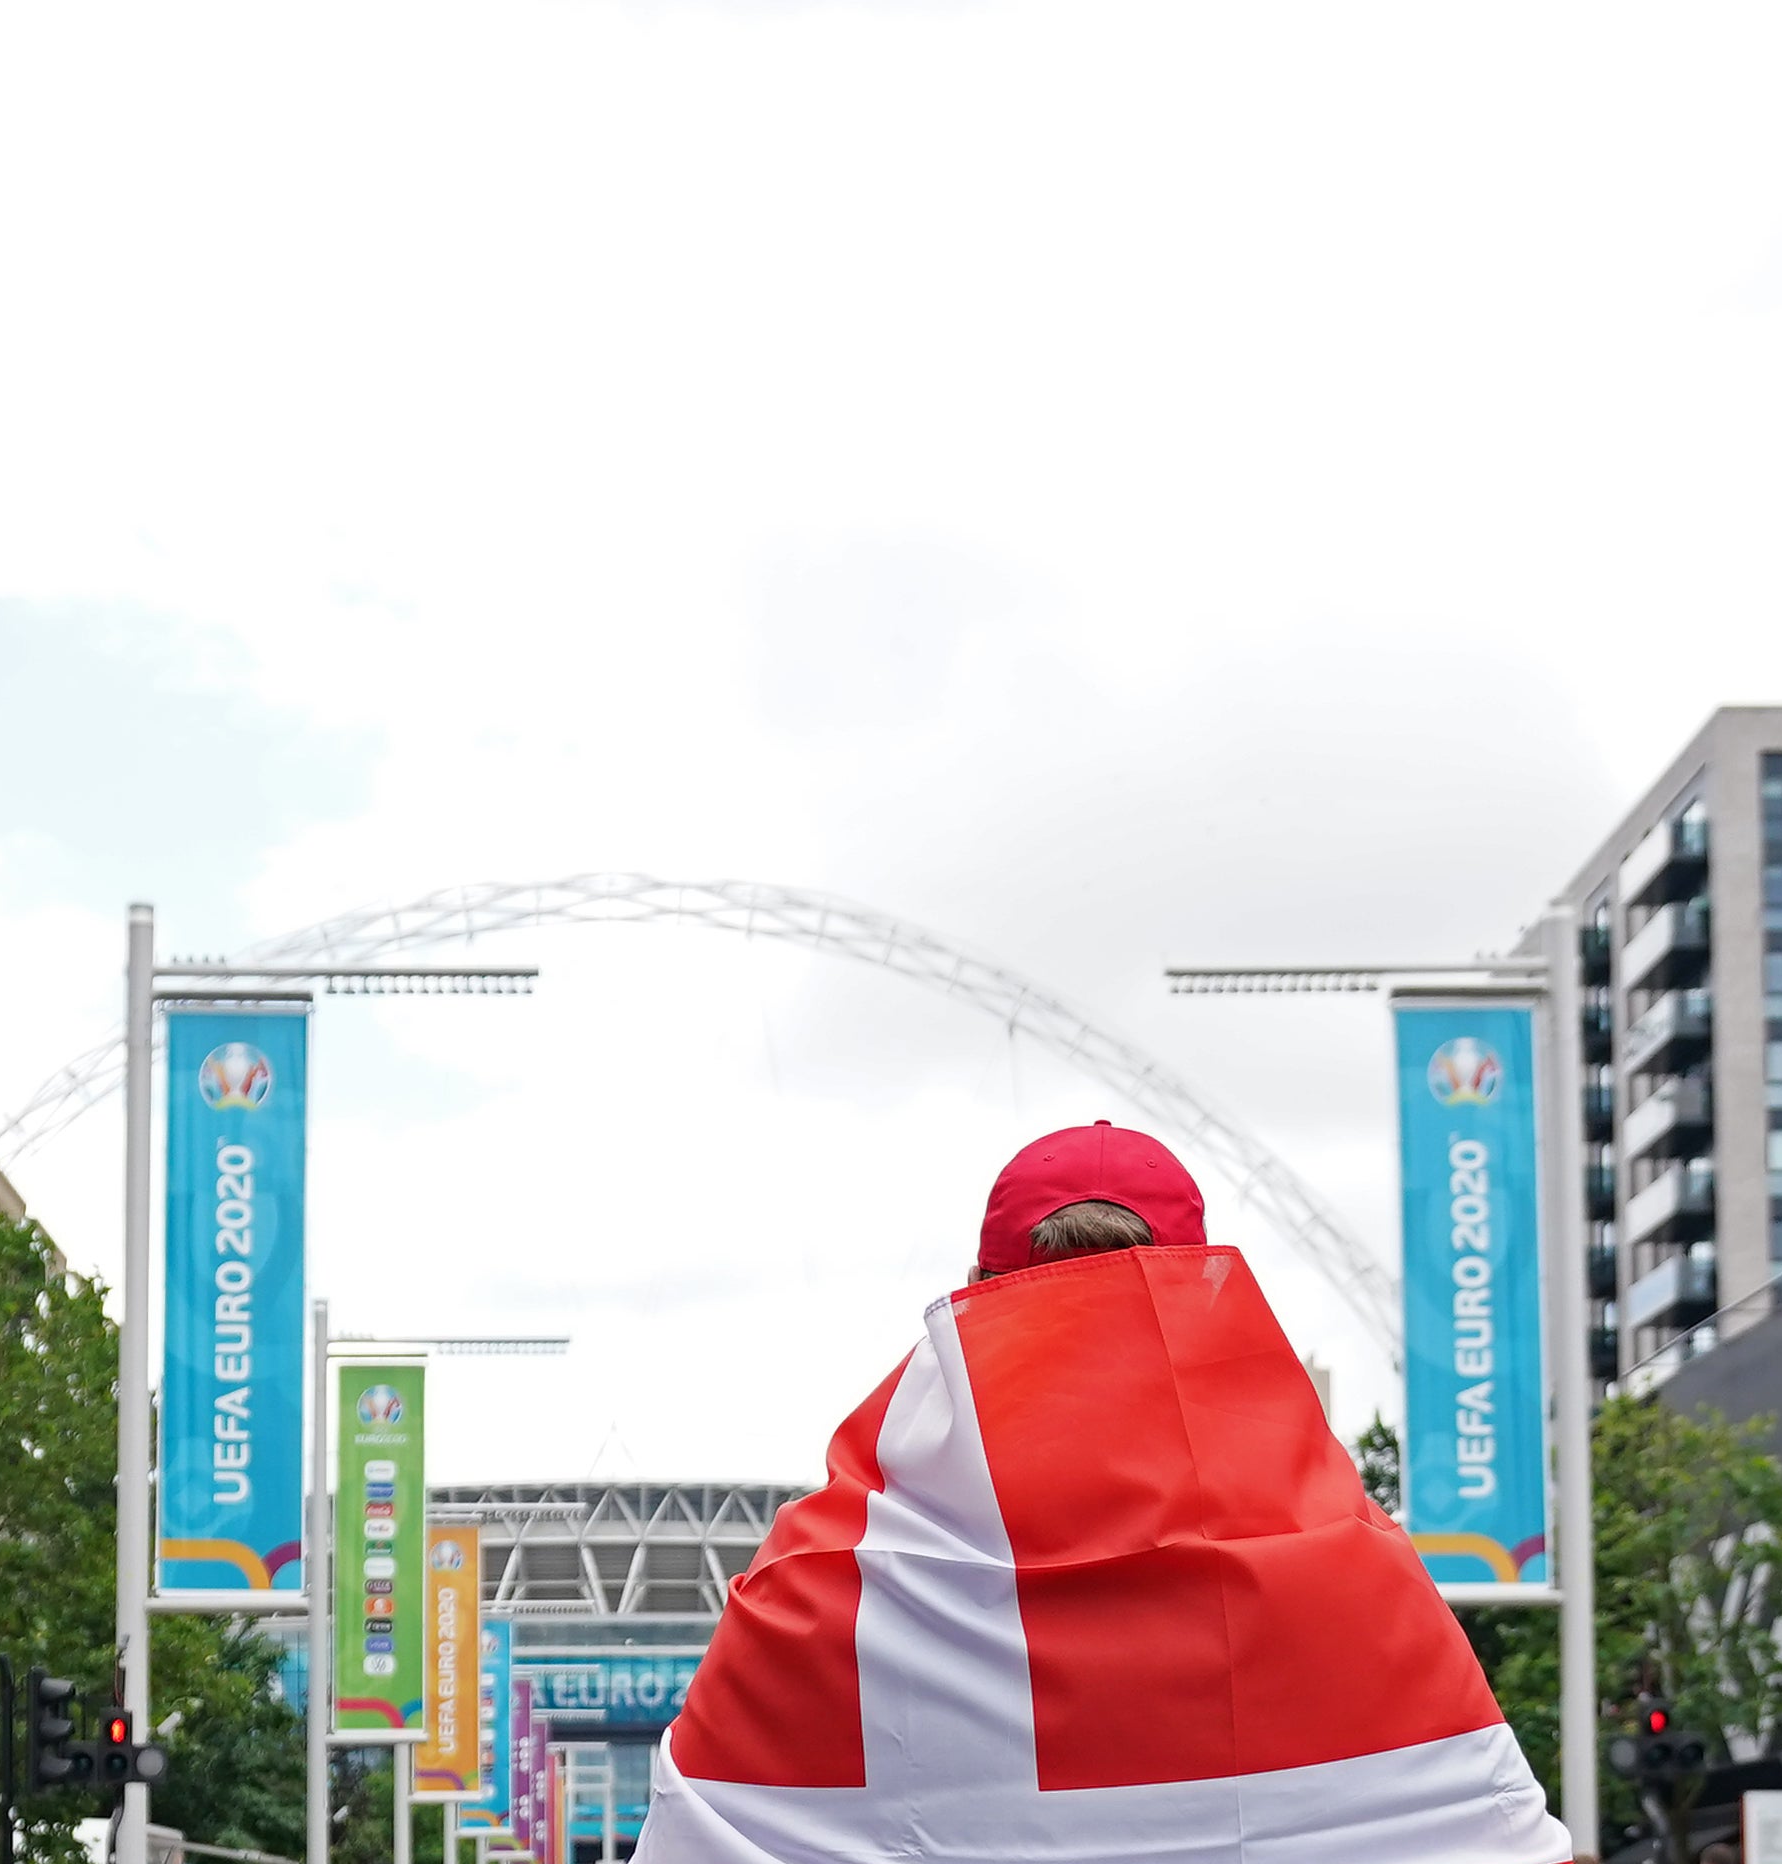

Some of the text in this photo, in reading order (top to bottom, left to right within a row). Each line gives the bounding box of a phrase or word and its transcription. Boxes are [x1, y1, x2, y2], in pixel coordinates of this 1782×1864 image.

[213, 1143, 254, 1504] UEFA EURO 2020
[1449, 1138, 1497, 1500] UEFA EURO 2020
[438, 1586, 458, 1755] UEFA EURO 2020
[552, 1670, 667, 1707] EURO
